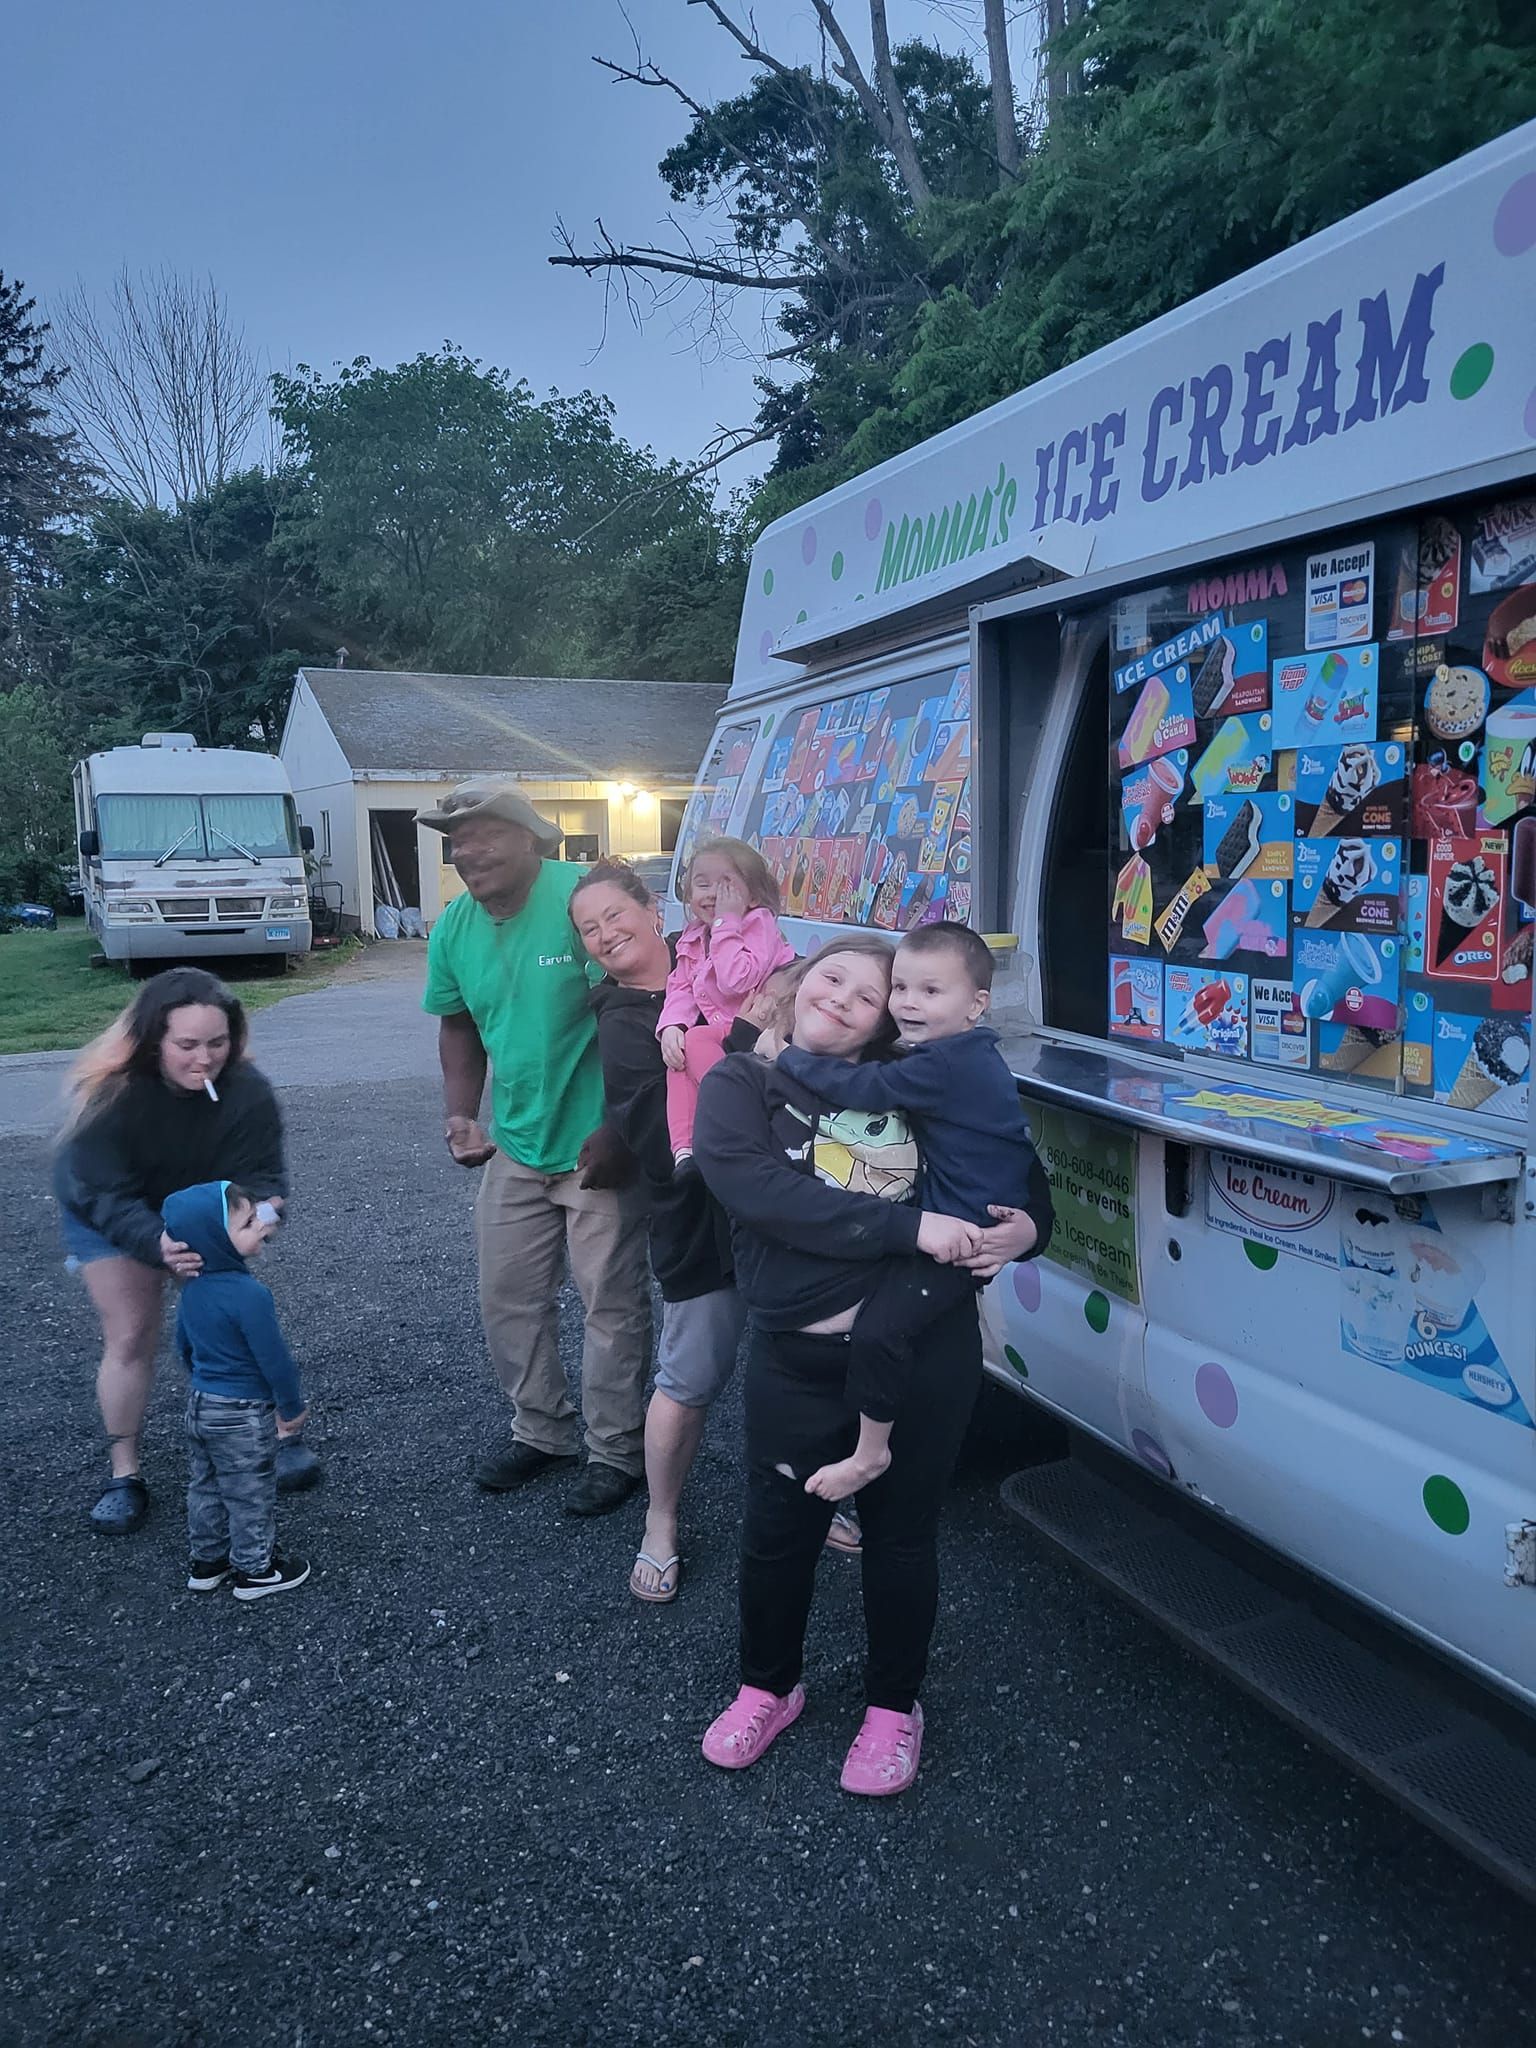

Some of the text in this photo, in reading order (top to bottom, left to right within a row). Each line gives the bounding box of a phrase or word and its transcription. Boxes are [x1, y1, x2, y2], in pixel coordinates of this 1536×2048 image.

[1030, 408, 1127, 532] ICE
[1141, 261, 1446, 504] CREAM
[1310, 550, 1371, 580] We Accept
[1187, 562, 1289, 614] MOMMA
[1314, 592, 1334, 606] VISA
[1117, 616, 1220, 690] ICE CREAM
[1158, 713, 1185, 731] Cotton
[1362, 811, 1391, 823] CONE
[1360, 906, 1390, 918] CONE
[1454, 951, 1492, 964] OREO
[1254, 985, 1291, 1003] We Acc
[1258, 1015, 1276, 1026] VISA
[1212, 1027, 1240, 1041] Original
[1047, 1146, 1130, 1195] 860-608-4046
[1066, 1175, 1083, 1199] for
[1087, 1189, 1130, 1219] events
[1226, 1166, 1248, 1195] Ice
[1252, 1176, 1311, 1214] Cream
[1065, 1218, 1132, 1270] Icecream
[1416, 1311, 1437, 1340] 6
[1405, 1341, 1467, 1362] OUNCES!
[1468, 1370, 1506, 1392] HERSHEY'S
